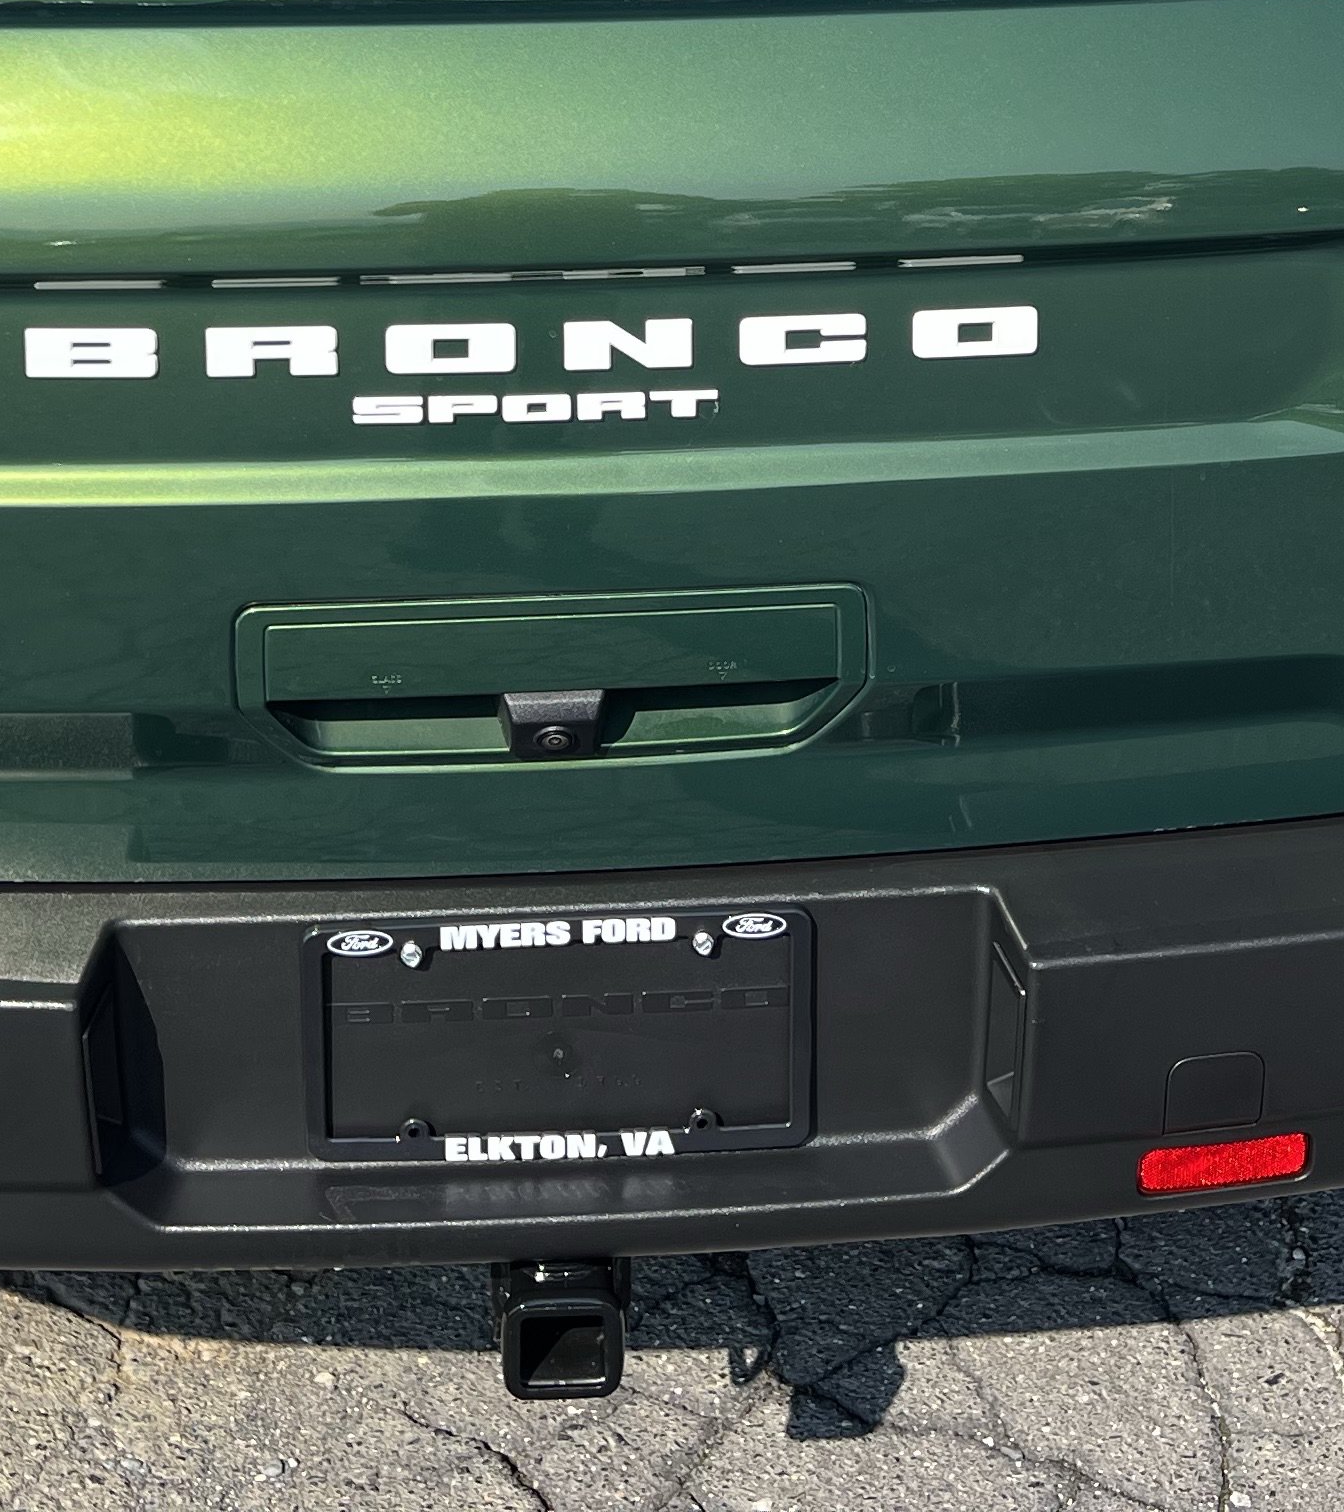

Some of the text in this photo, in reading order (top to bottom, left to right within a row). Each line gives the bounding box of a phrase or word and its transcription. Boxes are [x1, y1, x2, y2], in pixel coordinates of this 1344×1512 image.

[24, 304, 1040, 379] BRONCO
[352, 388, 720, 425] SPORT
[340, 933, 382, 952] Ford
[439, 916, 676, 951] MYERS FORD
[735, 917, 775, 934] Ford
[327, 985, 790, 1026] BRONCO
[444, 1129, 676, 1162] ELKTON, VA
